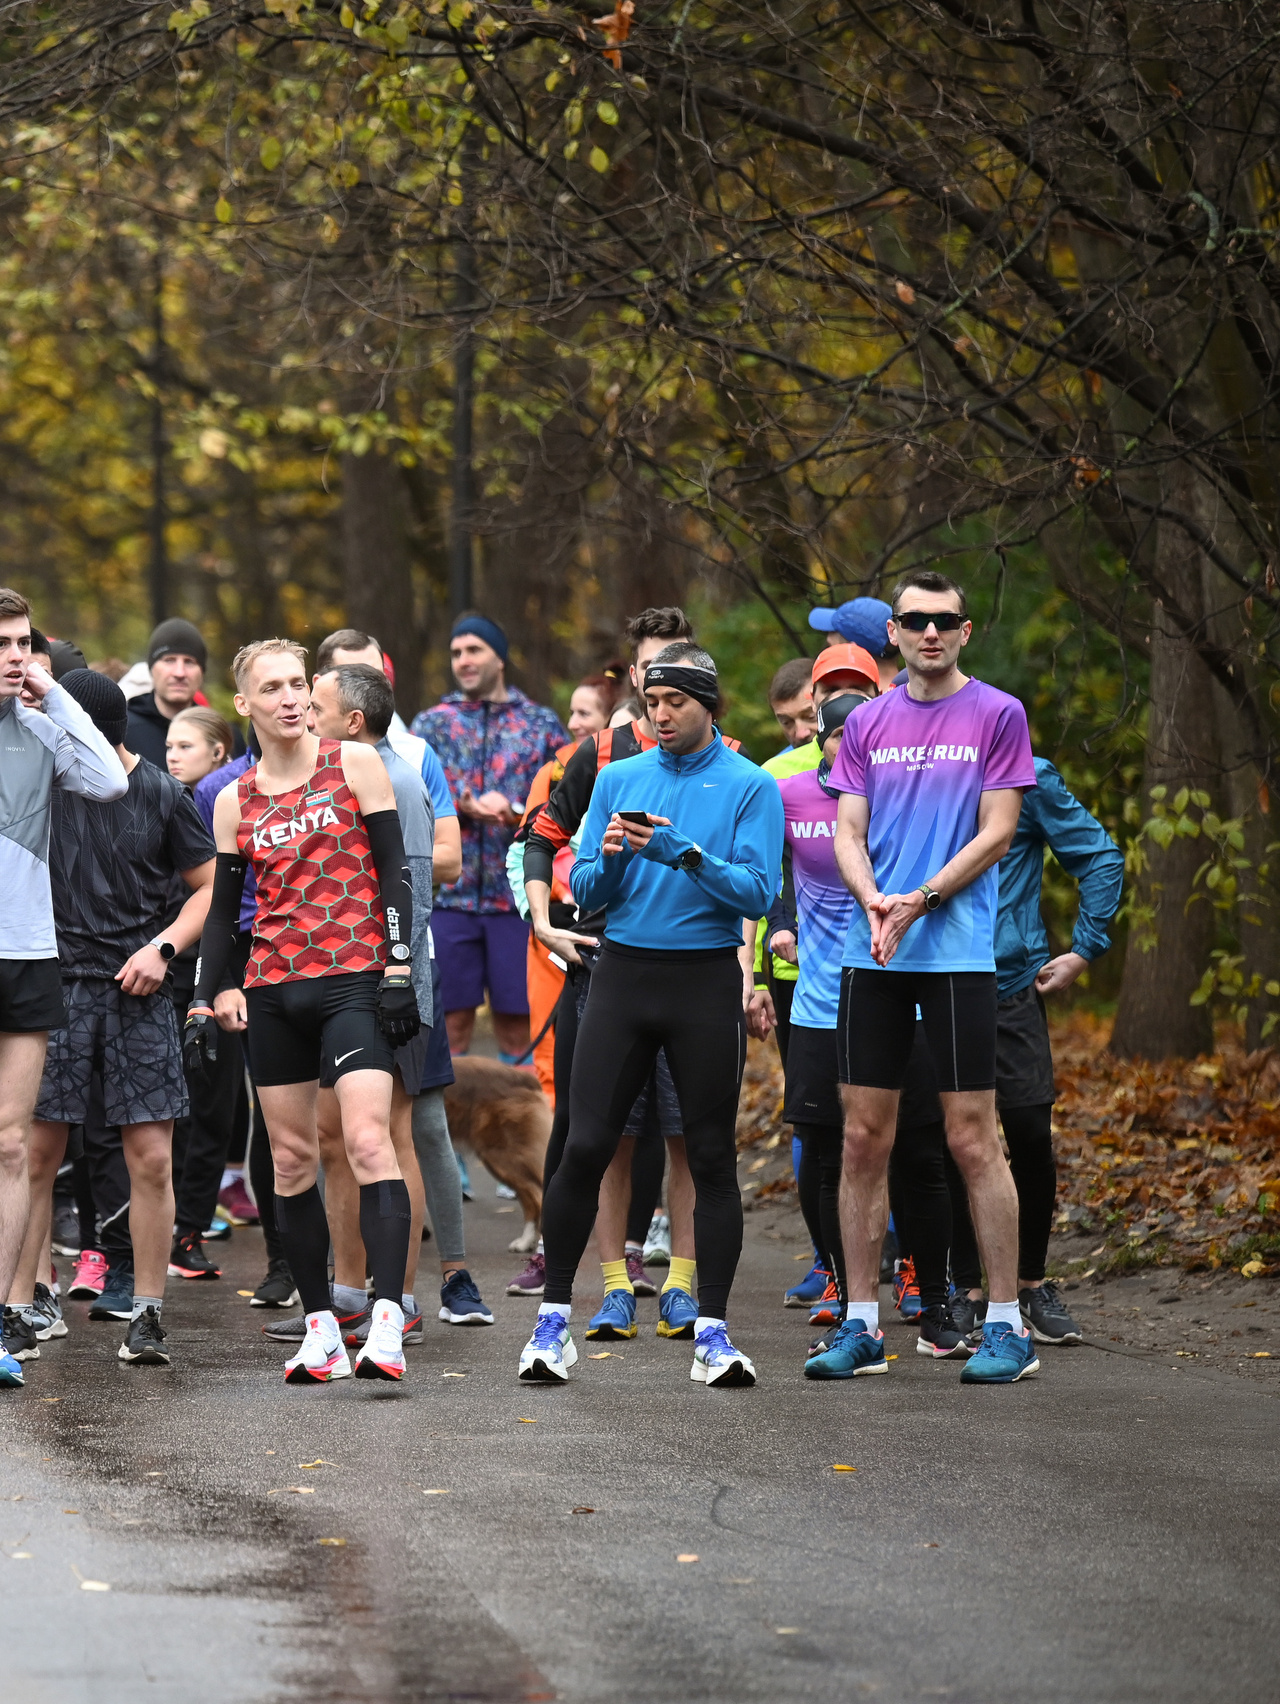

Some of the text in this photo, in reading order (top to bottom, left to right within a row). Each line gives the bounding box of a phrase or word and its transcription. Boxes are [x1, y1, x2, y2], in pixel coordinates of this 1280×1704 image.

[869, 745, 927, 765] WAKE
[933, 745, 979, 762] RUN
[252, 806, 340, 852] KENYA
